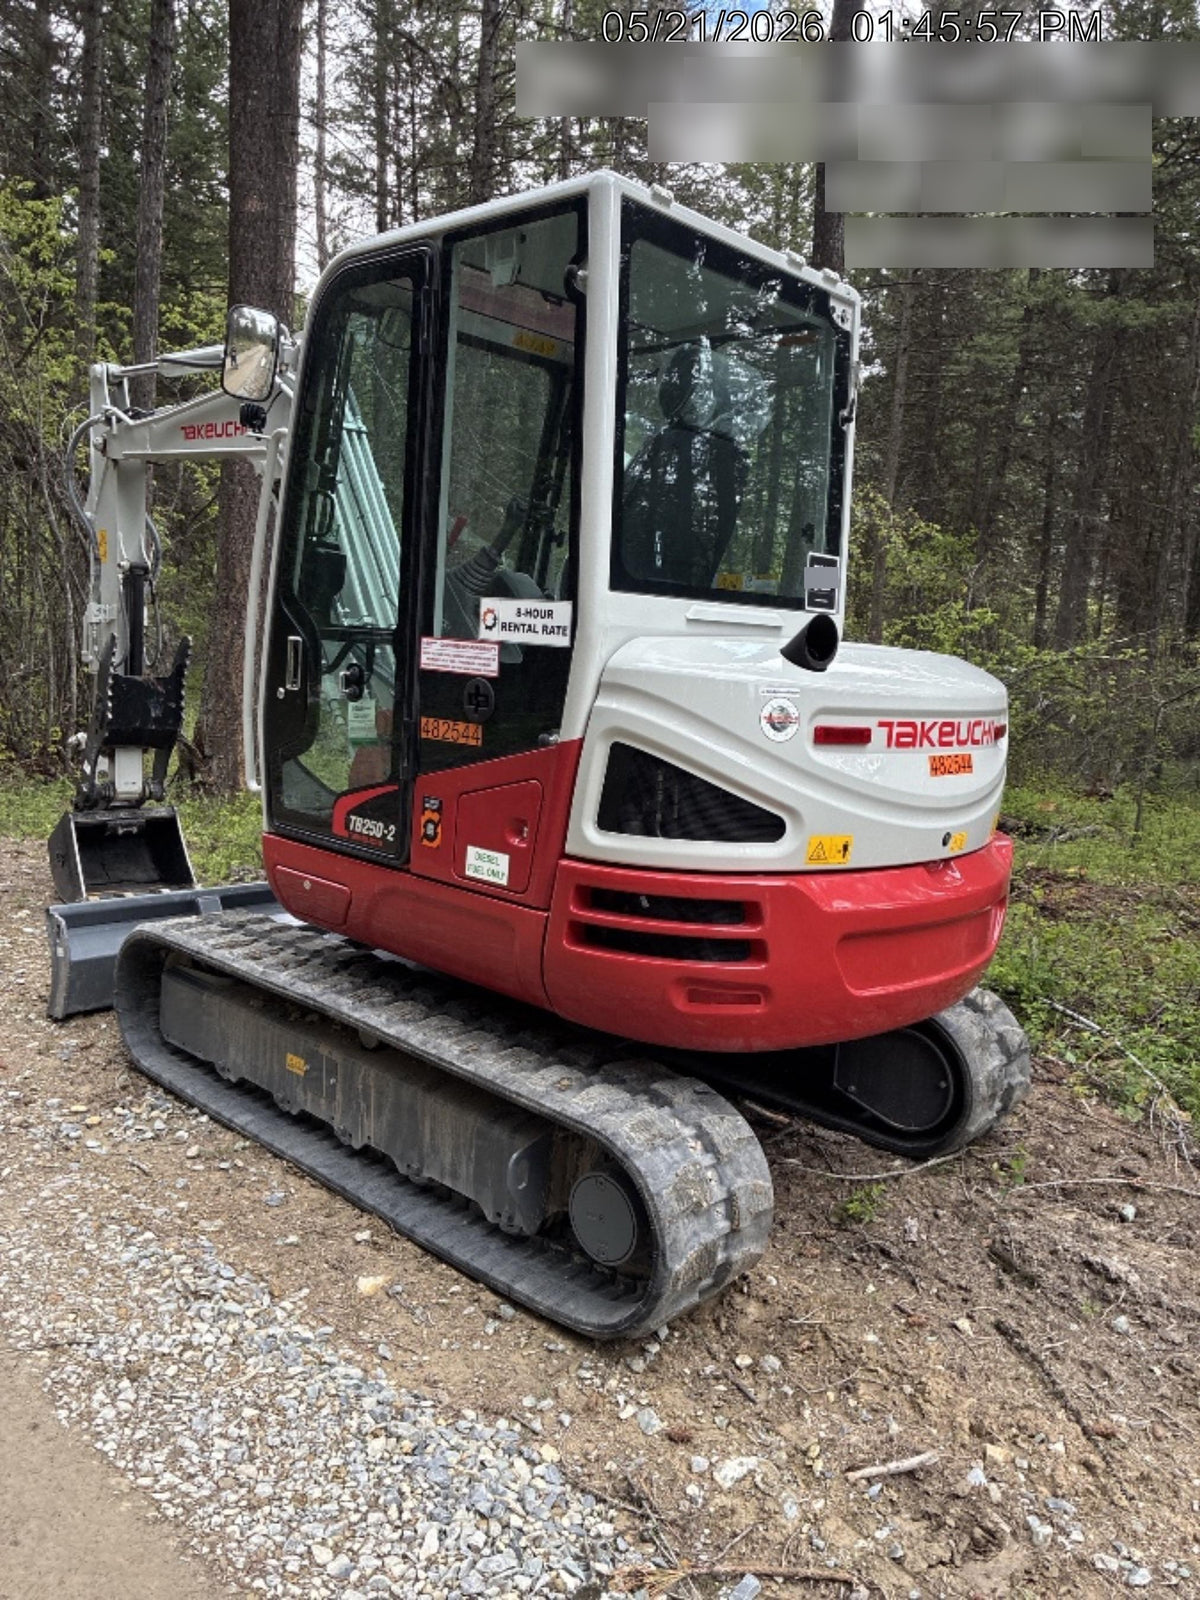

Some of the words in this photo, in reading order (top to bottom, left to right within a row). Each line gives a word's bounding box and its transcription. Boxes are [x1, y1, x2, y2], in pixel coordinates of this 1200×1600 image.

[515, 607, 554, 620] 8-HOUR
[500, 621, 539, 635] RENTAL
[541, 624, 568, 637] RATE
[422, 718, 481, 745] 482544
[929, 754, 973, 776] 482544
[348, 814, 397, 842] TB250-2
[474, 851, 501, 867] DIESEL
[467, 863, 485, 876] FUEL
[486, 867, 506, 881] ONLY
